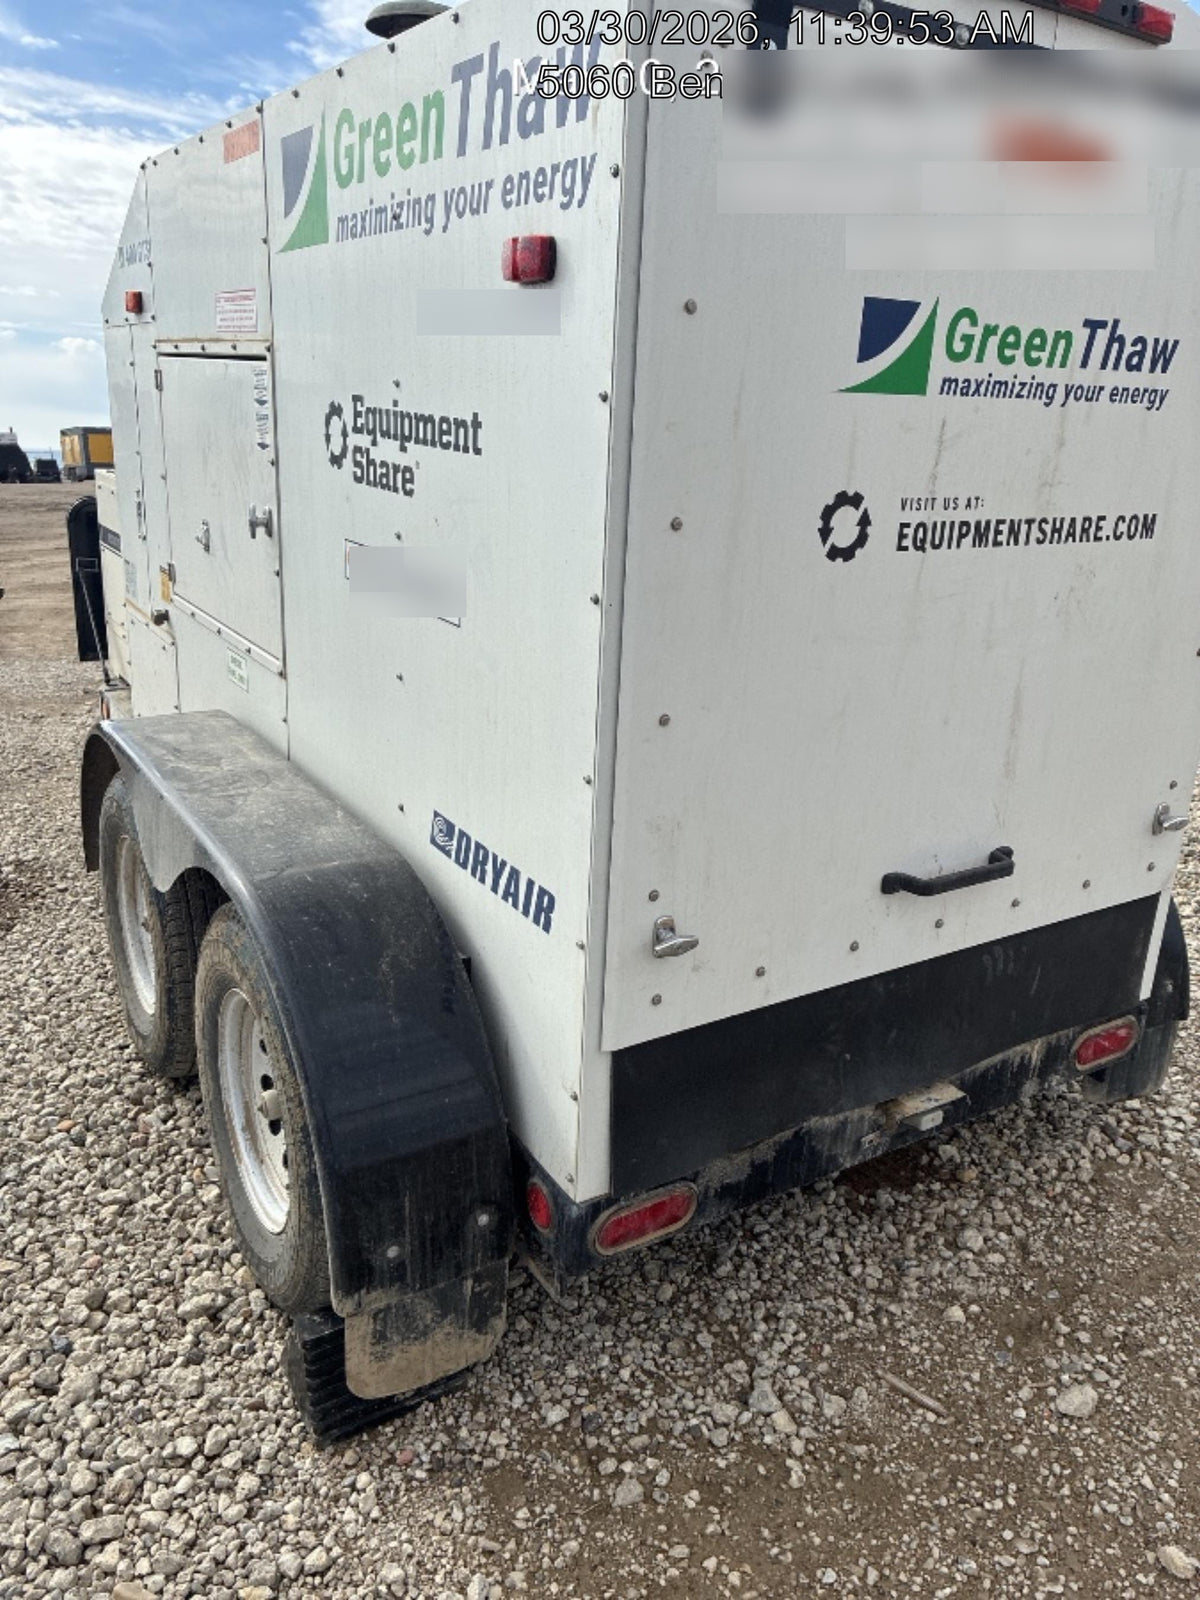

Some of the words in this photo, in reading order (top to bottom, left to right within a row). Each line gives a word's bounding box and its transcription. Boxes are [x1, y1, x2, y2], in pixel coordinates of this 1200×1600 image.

[335, 187, 437, 243] maximizing
[442, 177, 496, 234] your
[501, 152, 598, 211] energy
[939, 373, 1058, 408] maximizing
[1058, 383, 1105, 408] your
[1109, 385, 1170, 411] energy
[351, 394, 483, 456] Equipment
[352, 445, 415, 498] Share
[901, 497, 937, 511] VISIT
[943, 497, 959, 511] US
[965, 496, 985, 511] AT:
[896, 513, 1158, 553] EQUIPMENTSHARE.COM
[454, 827, 556, 935] DRYAIR
